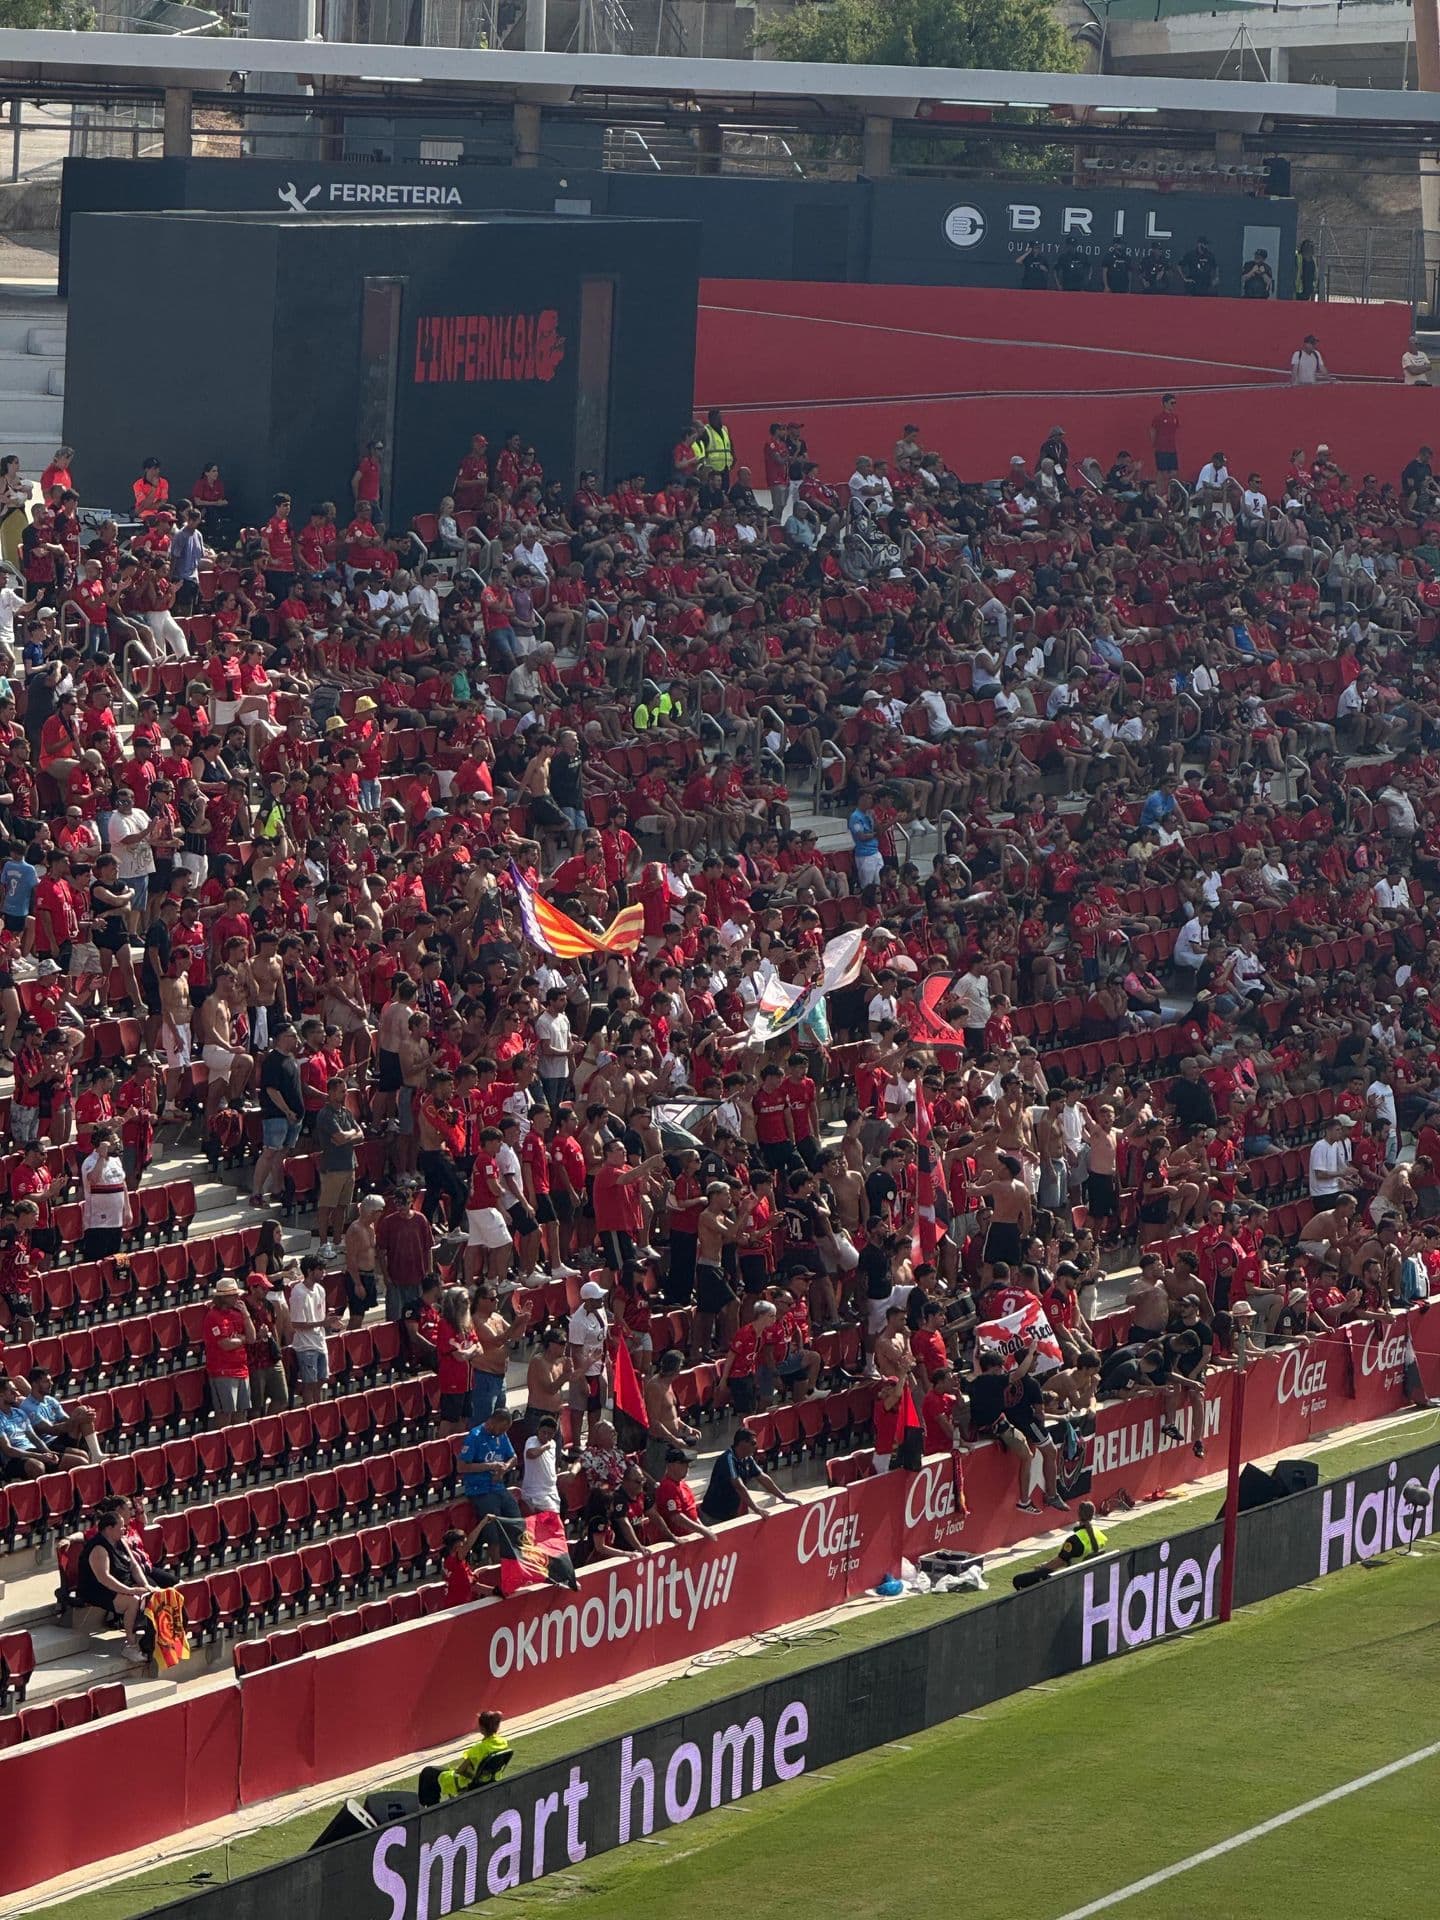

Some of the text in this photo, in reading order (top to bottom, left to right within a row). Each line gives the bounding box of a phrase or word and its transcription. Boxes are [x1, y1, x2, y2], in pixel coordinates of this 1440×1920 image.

[330, 184, 462, 204] FERRETERIA
[1006, 204, 1172, 239] BRIL
[1092, 1418, 1154, 1475] RELLA
[934, 1522, 945, 1543] by
[1320, 1461, 1440, 1576] Haier
[828, 1559, 839, 1581] by
[1082, 1541, 1222, 1665] Haier
[372, 1701, 809, 1920] Smart home
